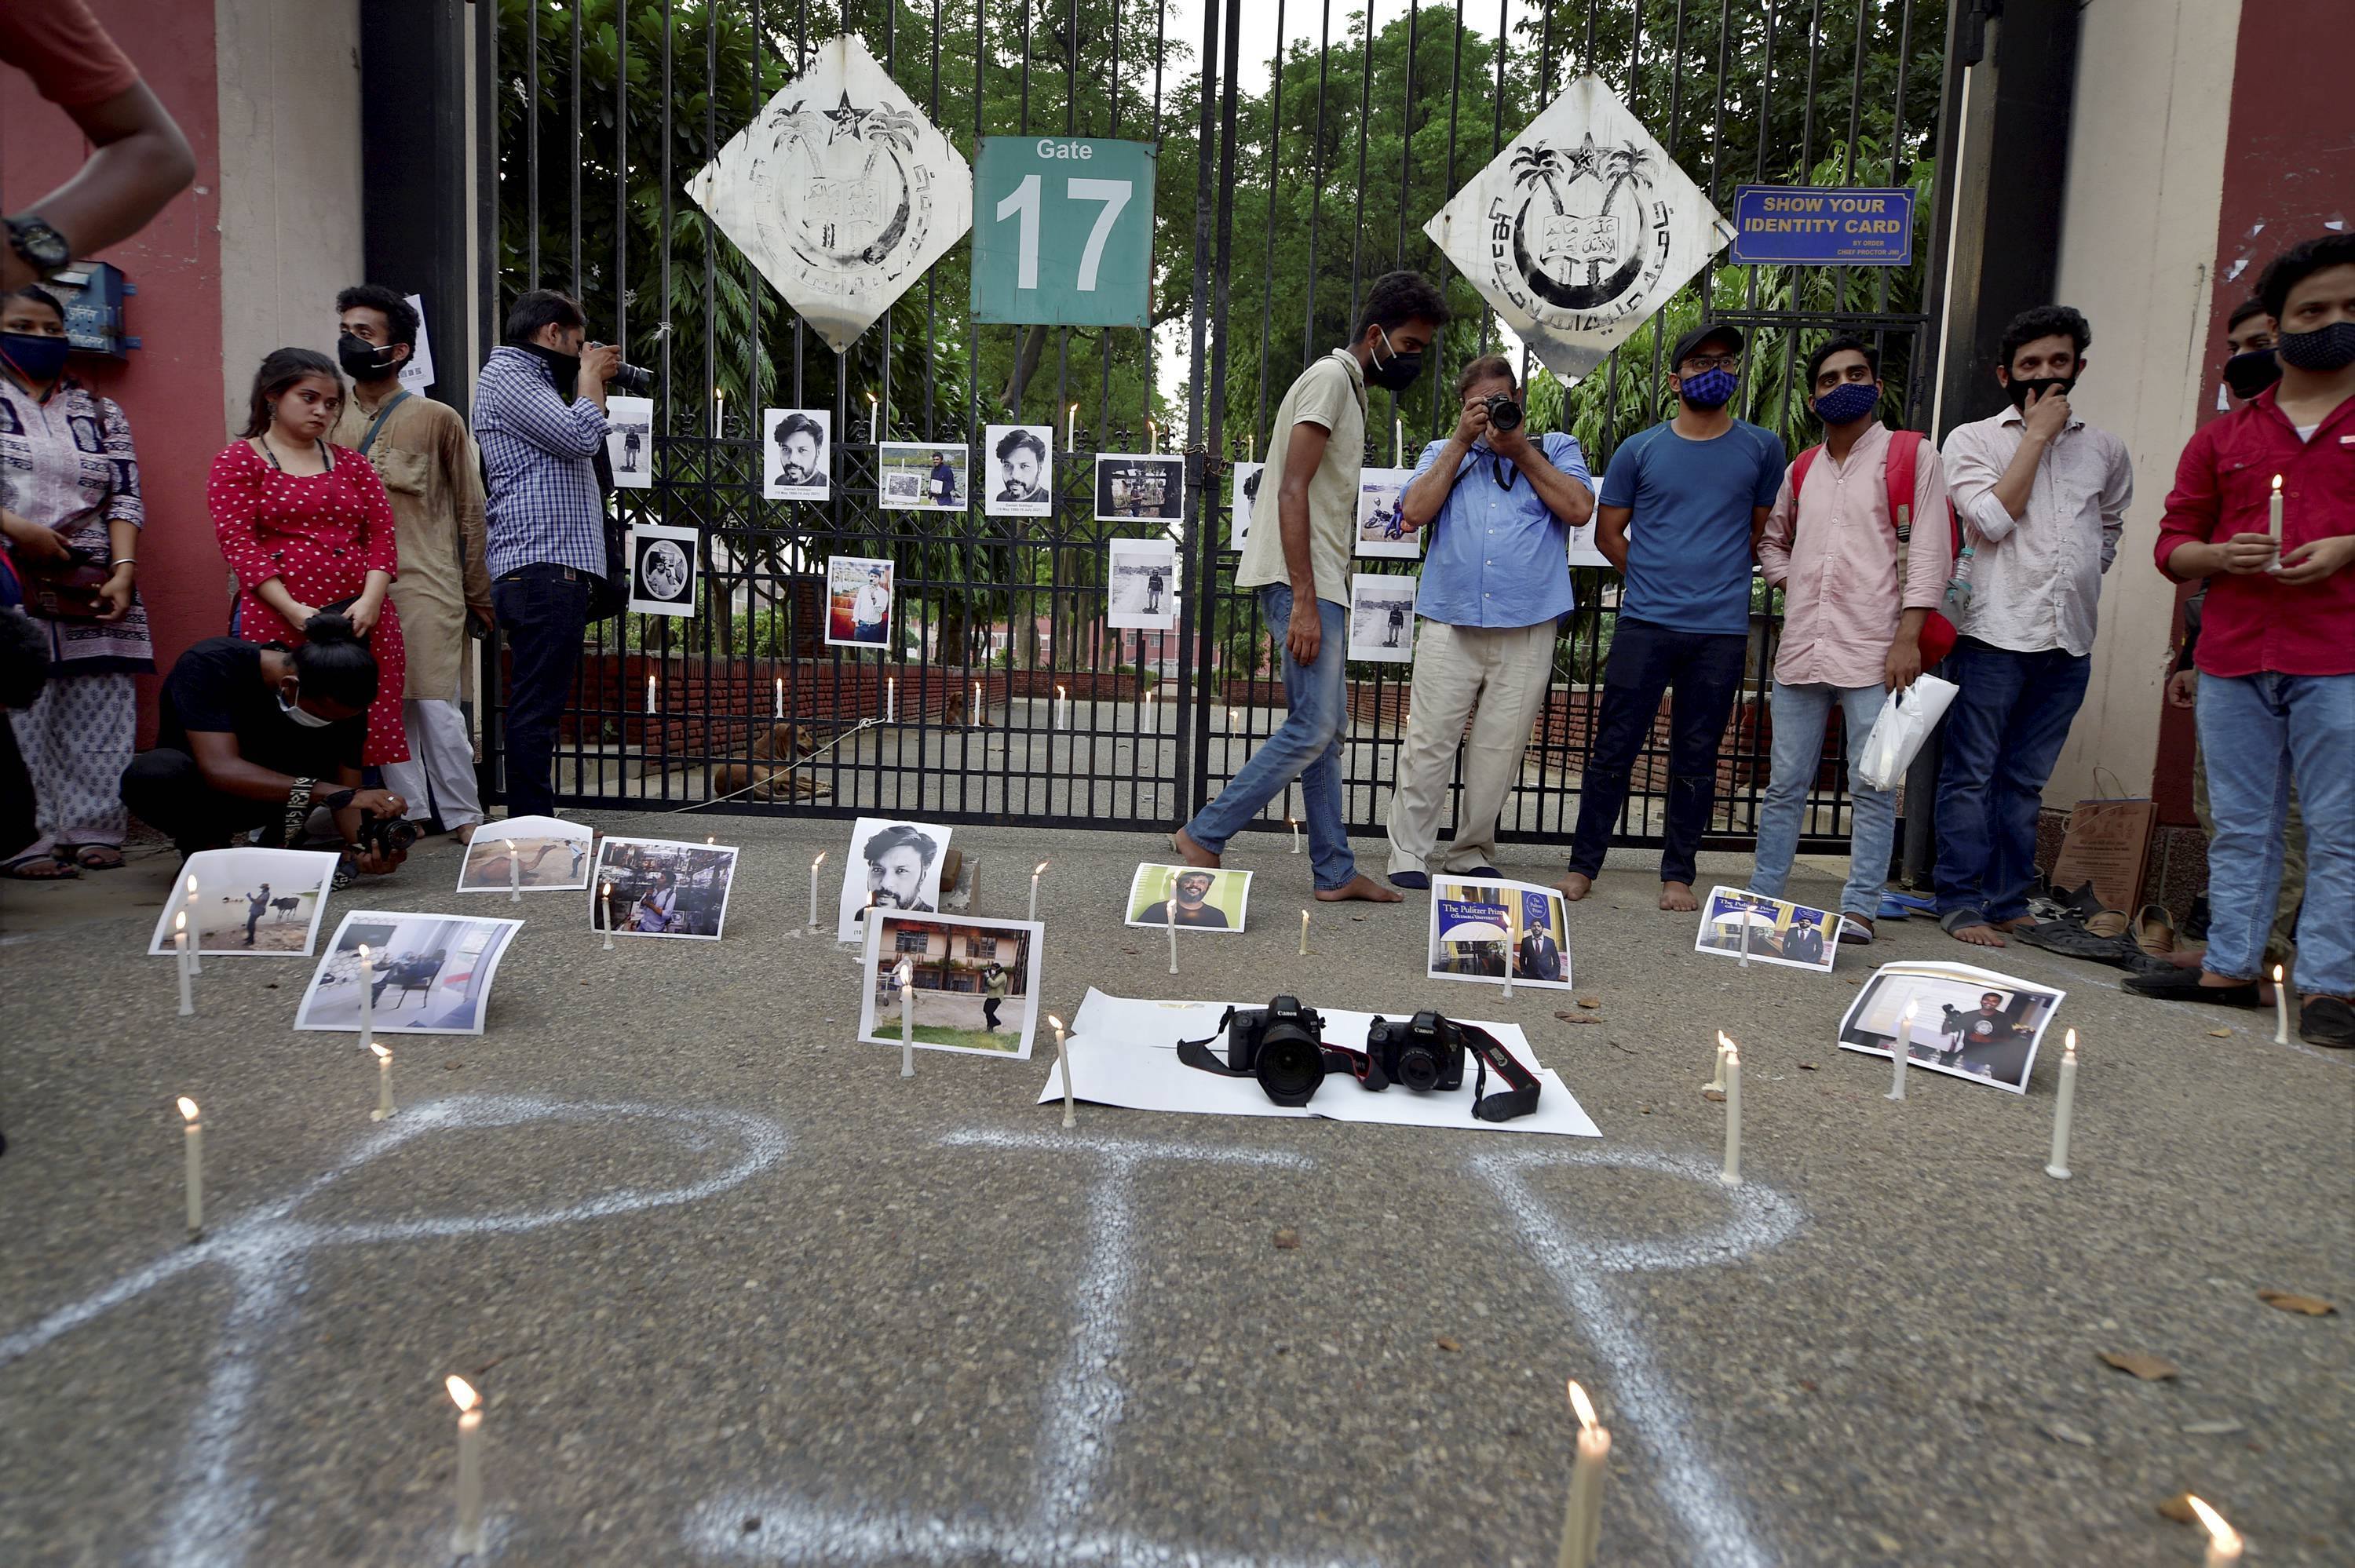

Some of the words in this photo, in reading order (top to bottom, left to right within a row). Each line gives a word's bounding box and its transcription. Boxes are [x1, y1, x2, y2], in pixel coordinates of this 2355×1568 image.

[1036, 139, 1092, 159] Gate
[1763, 197, 1823, 213] SHOW
[1829, 199, 1886, 213] YOUR
[996, 174, 1133, 291] 17
[1744, 217, 1839, 233] IDENTITY
[1845, 219, 1901, 234] CARD
[1443, 903, 1459, 913] The
[1460, 905, 1486, 915] Pulitzer
